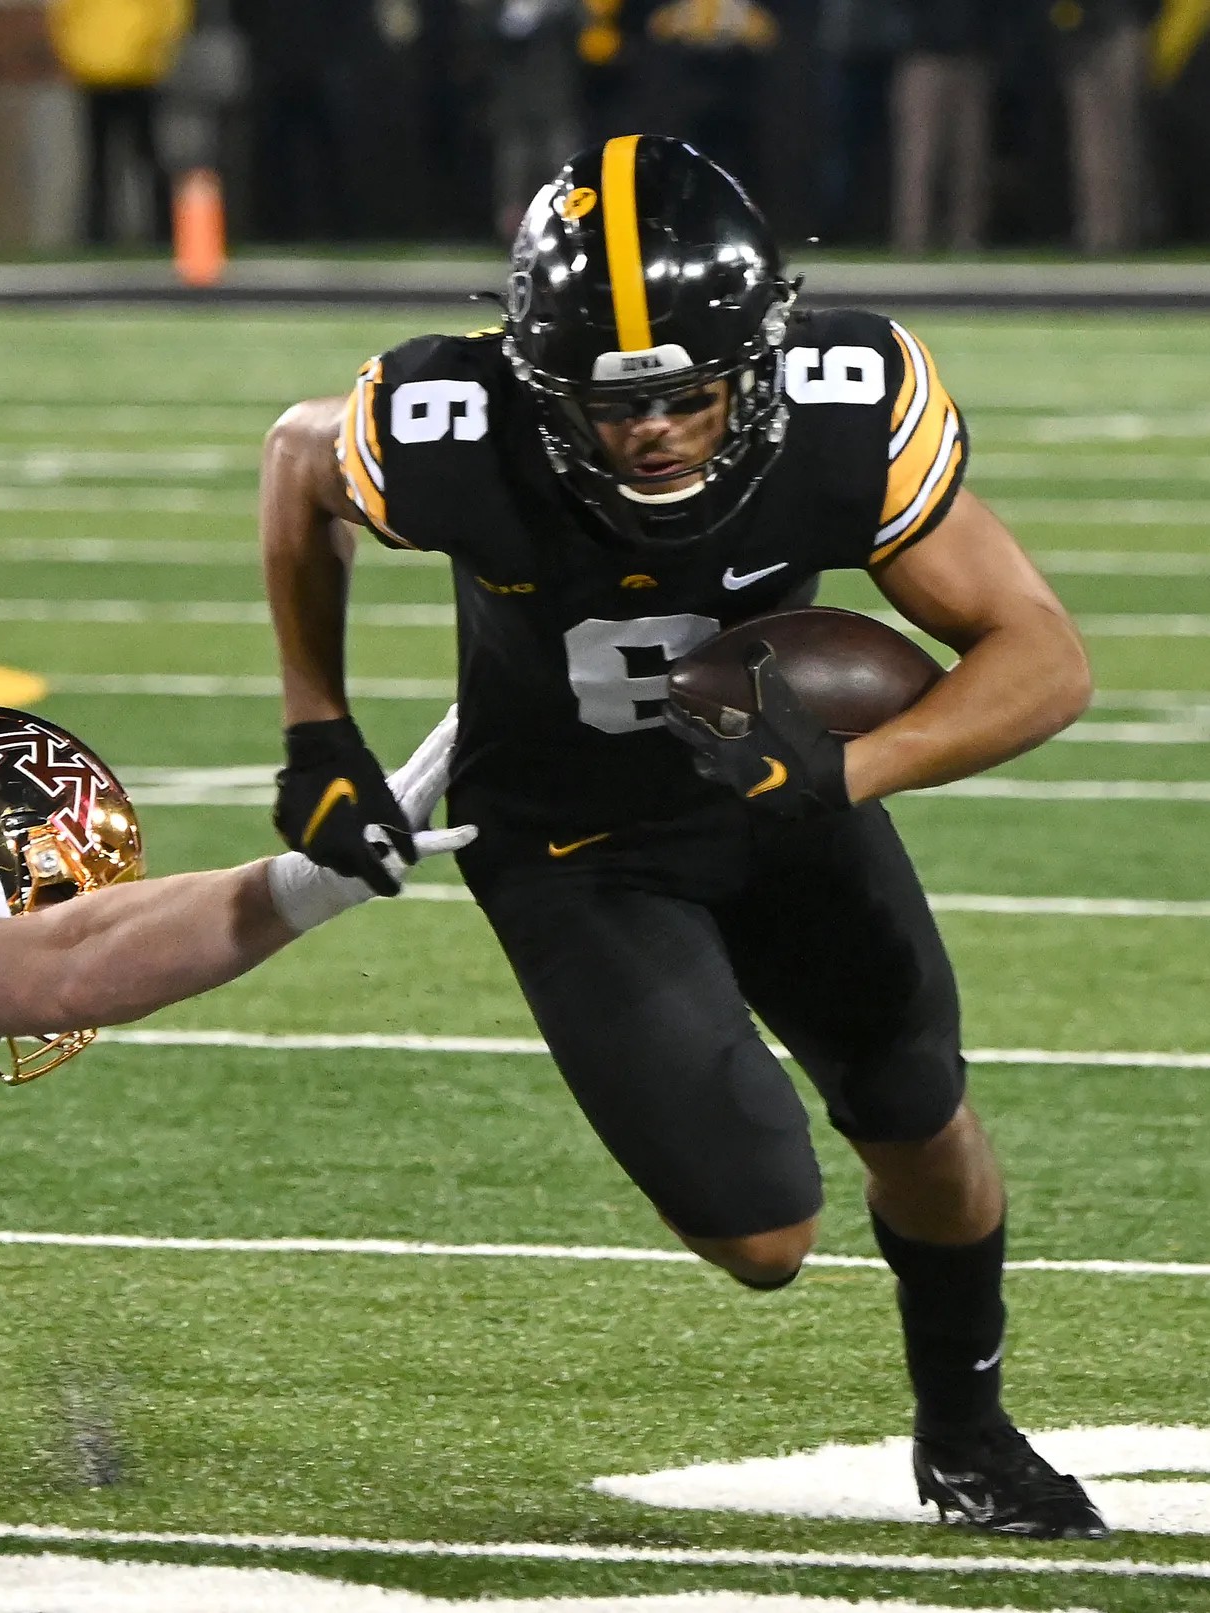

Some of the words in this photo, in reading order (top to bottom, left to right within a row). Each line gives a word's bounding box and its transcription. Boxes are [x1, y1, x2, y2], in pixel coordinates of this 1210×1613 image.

[784, 345, 886, 405] 6
[390, 380, 489, 444] 6
[564, 613, 720, 734] 6
